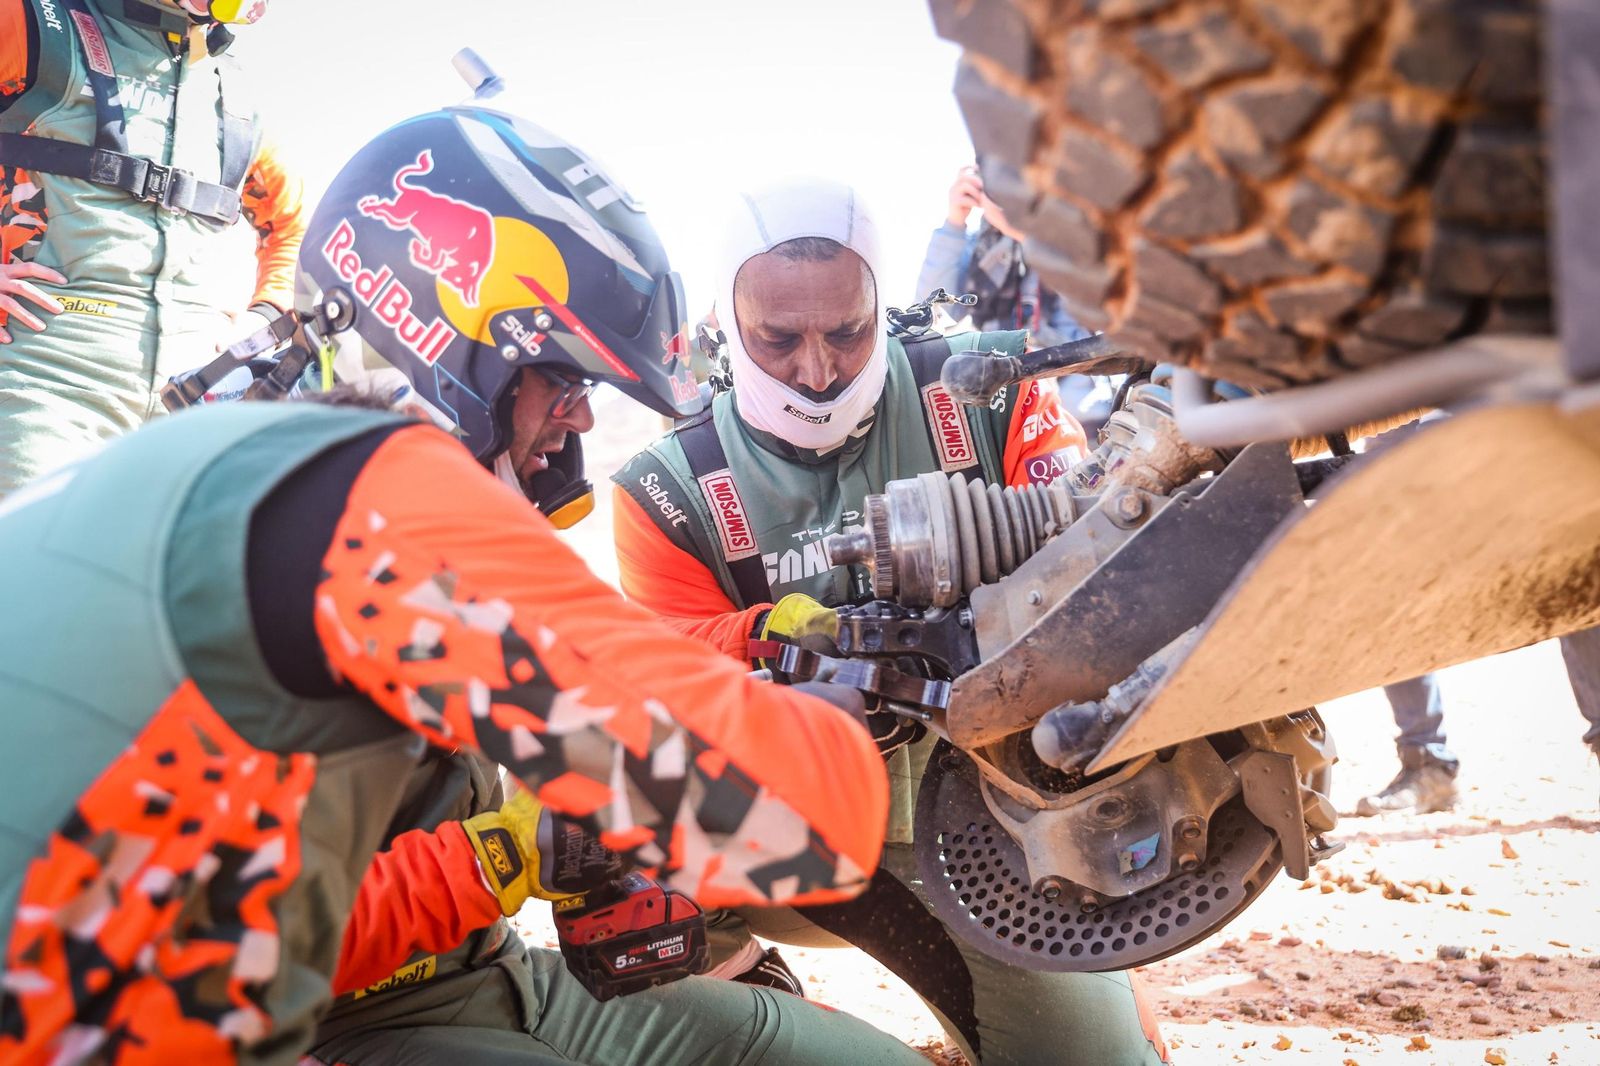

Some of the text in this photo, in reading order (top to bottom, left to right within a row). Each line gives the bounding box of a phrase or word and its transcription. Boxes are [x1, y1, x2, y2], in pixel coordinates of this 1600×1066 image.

[500, 314, 542, 356] Stilo
[788, 406, 829, 424] Sabelt
[933, 392, 966, 458] SIMPSON
[640, 472, 689, 528] Sabelt
[712, 481, 750, 547] SIMPSON
[659, 943, 684, 958] M18
